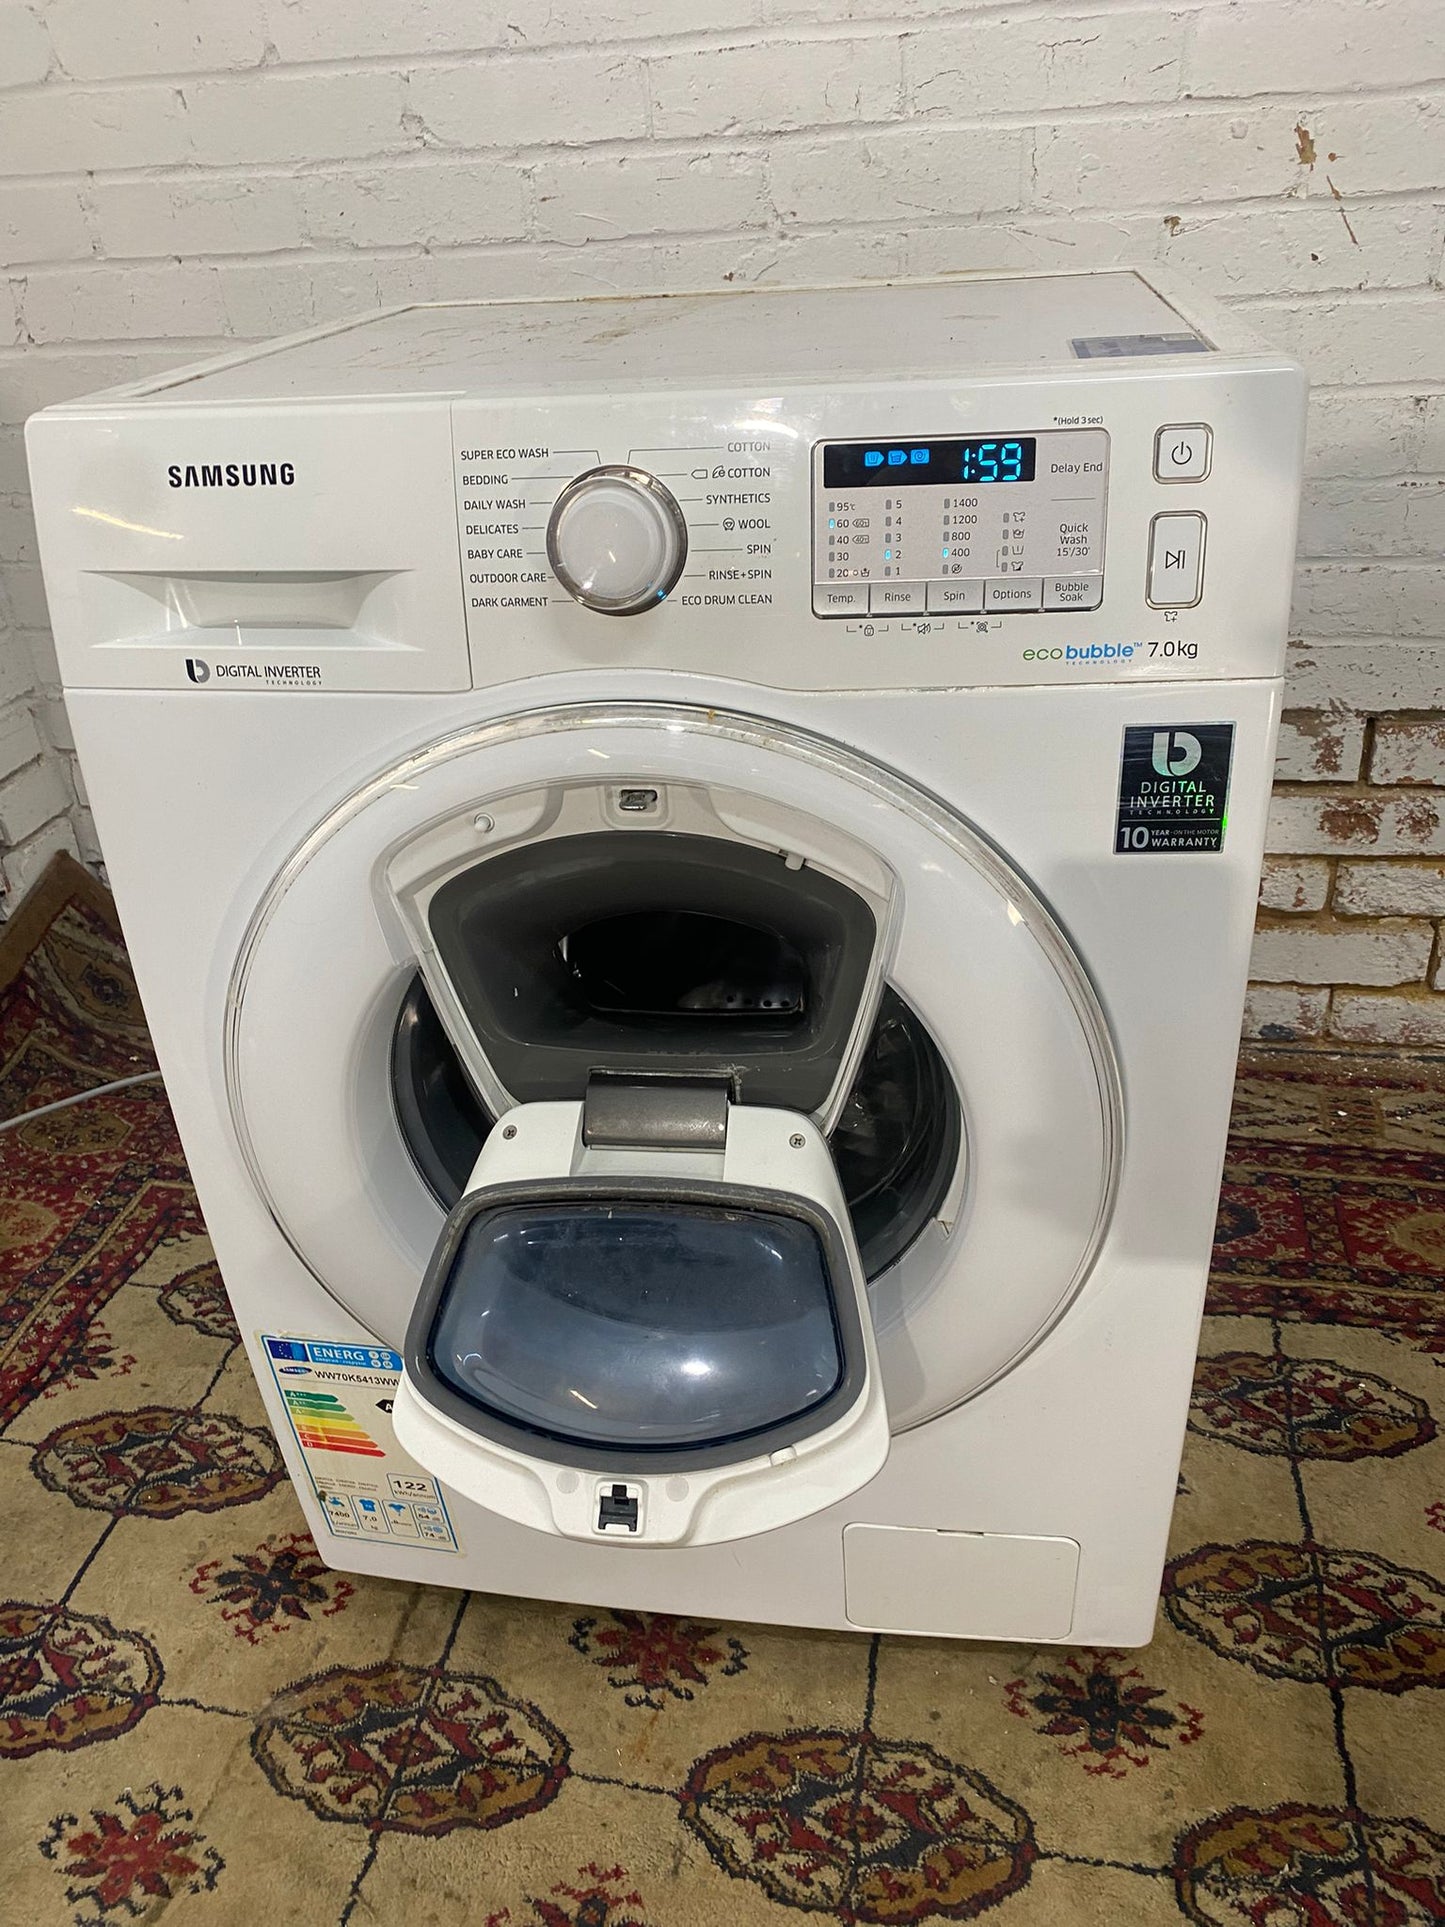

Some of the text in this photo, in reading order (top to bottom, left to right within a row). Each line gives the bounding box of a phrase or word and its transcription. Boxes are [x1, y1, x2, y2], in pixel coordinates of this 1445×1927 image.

[1080, 416, 1086, 424] 3
[1087, 415, 1104, 424] sec)
[727, 442, 770, 452] COTTON
[461, 448, 549, 461] SUPER ECO WASH
[963, 443, 1022, 482] 1:59
[1050, 462, 1103, 474] Delay End
[168, 463, 295, 488] SAMSUNG
[727, 467, 771, 478] COTTON
[462, 474, 509, 486] BEDDING
[706, 493, 771, 504] SYNTHETICS
[896, 500, 902, 508] 5
[953, 498, 978, 508] 1400
[464, 499, 526, 510] DAILY WASH
[738, 519, 771, 530] WOOL
[836, 519, 850, 528] 60
[896, 516, 902, 526] 4
[952, 514, 978, 524] 1200
[466, 524, 519, 535] DELICATES
[1059, 523, 1088, 534] Quick
[836, 536, 850, 544] 40
[896, 533, 902, 542] 3
[951, 532, 971, 541] 800
[1060, 534, 1088, 545] Wash
[468, 549, 524, 560] BABY CARE
[746, 544, 772, 554] SPIN
[896, 550, 902, 559] 2
[951, 548, 970, 557] 400
[836, 552, 850, 561] 30
[836, 568, 849, 578] 20
[896, 566, 901, 576] 1
[470, 572, 547, 584] OUTDOOR CARE
[1055, 582, 1089, 592] Bubble
[682, 594, 773, 606] ECO DRUM CLEAN
[827, 594, 856, 604] Temp.
[884, 592, 912, 602] Rinse
[944, 591, 966, 602] Spin
[992, 589, 1032, 600] Options
[1060, 592, 1084, 602] Soak
[472, 597, 549, 608] DARK GARMENT
[1022, 647, 1063, 661] eco
[1066, 658, 1133, 666] TECHNOLOGY
[216, 664, 322, 679] DIGITAL INVERTER
[1140, 780, 1206, 794] DIGITAL
[1130, 794, 1215, 808] INVERTER
[1130, 808, 1214, 816] TECHNOLOGY
[1120, 826, 1150, 848] 10
[1151, 837, 1217, 846] WARRANTY
[313, 1347, 364, 1361] ENERG
[393, 1480, 428, 1492] 122
